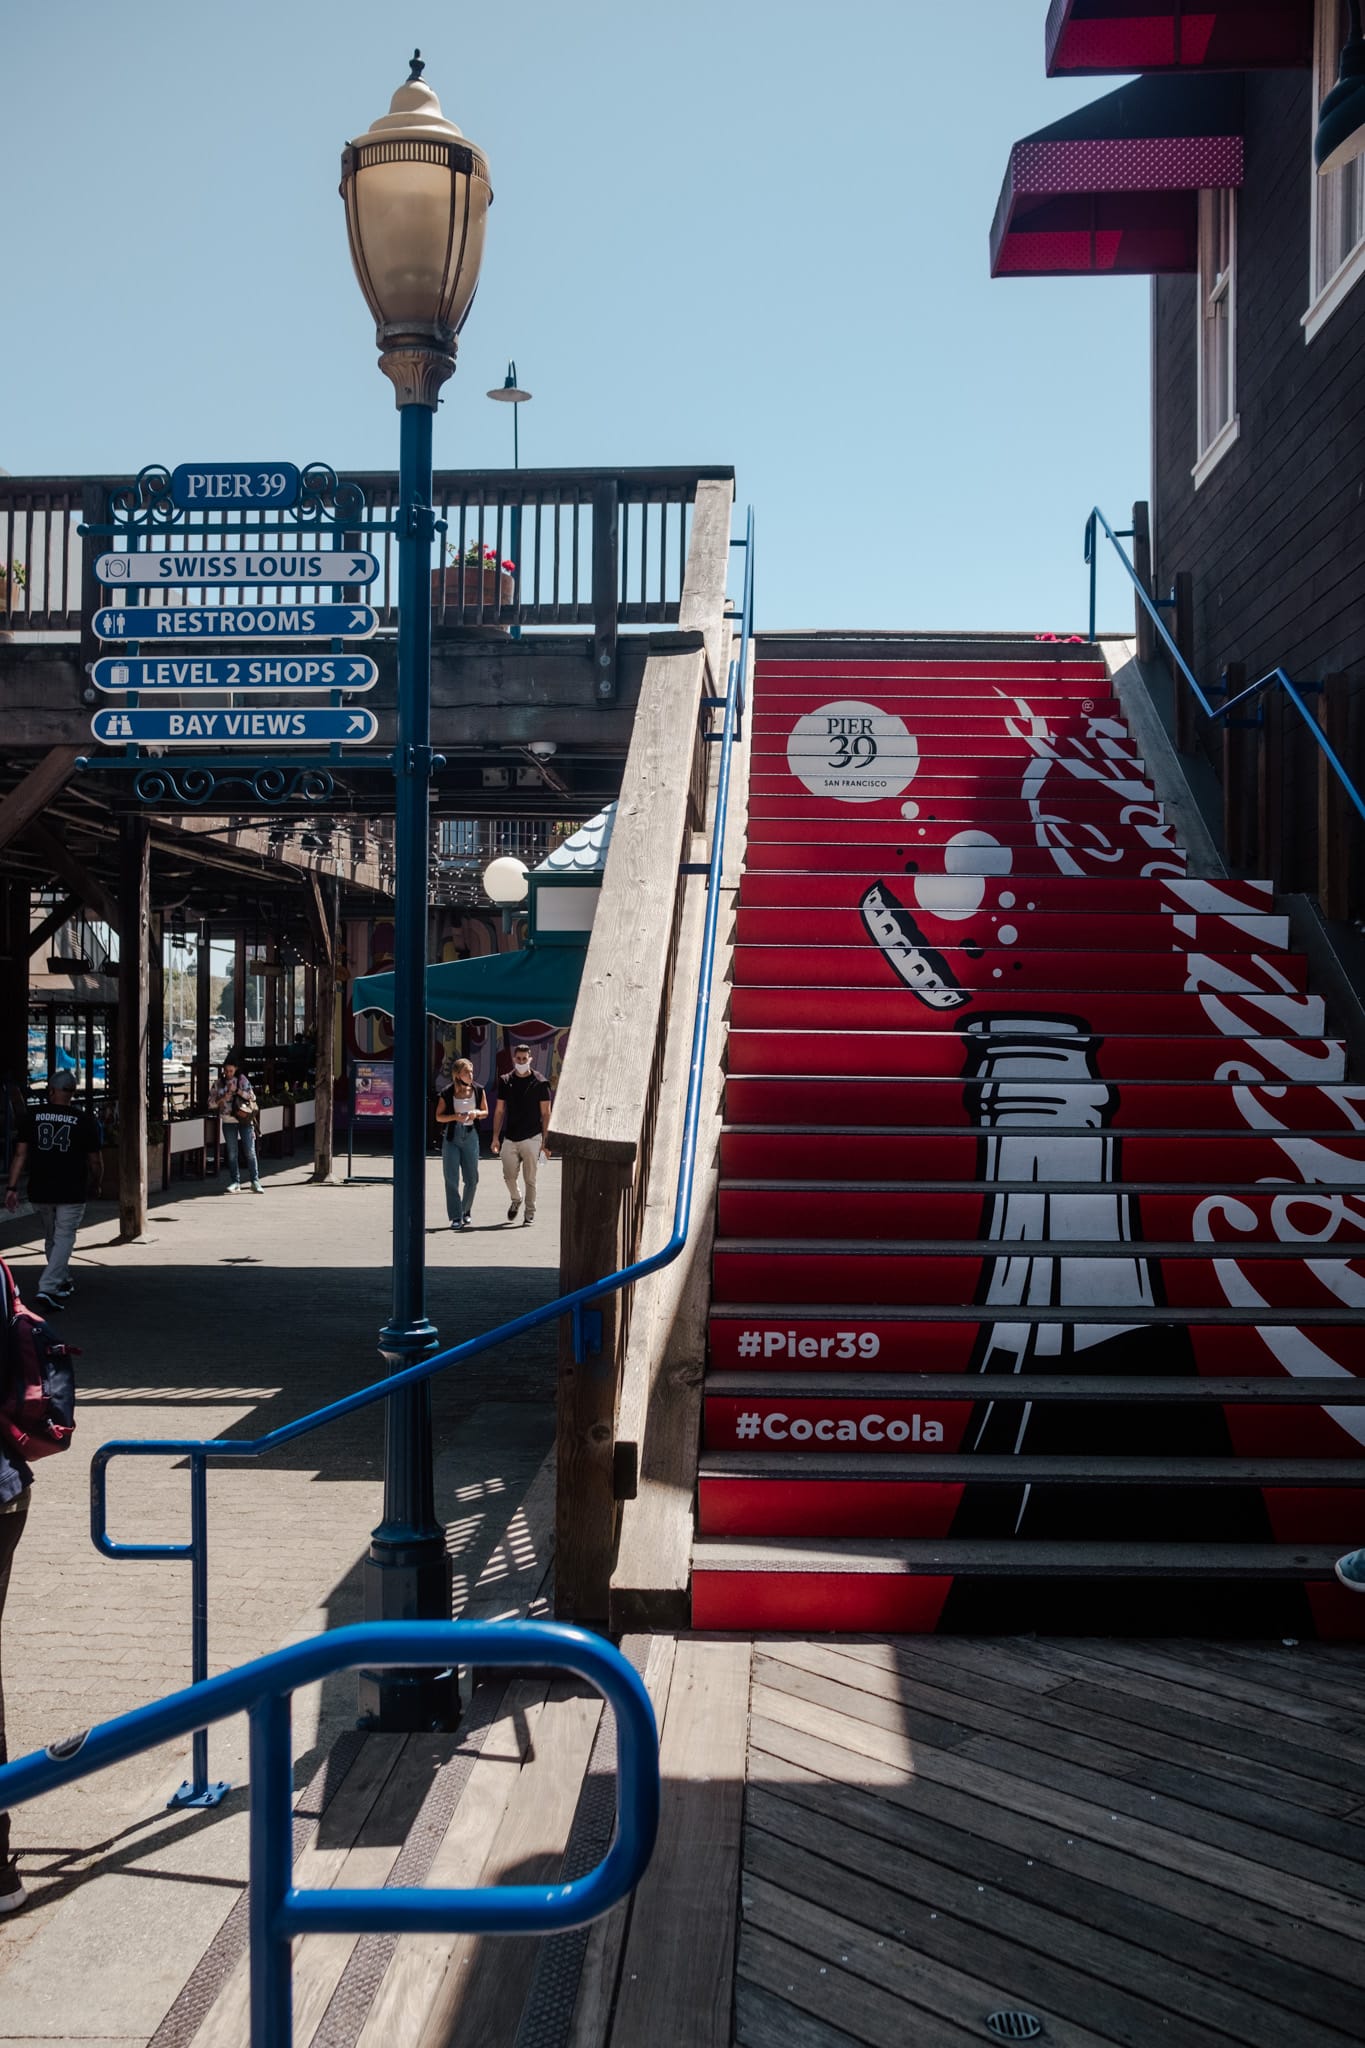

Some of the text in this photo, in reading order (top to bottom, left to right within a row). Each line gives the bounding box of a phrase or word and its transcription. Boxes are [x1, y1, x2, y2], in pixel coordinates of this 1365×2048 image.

[187, 473, 287, 498] PIER 39
[159, 556, 322, 578] SWISS LOUIS
[156, 610, 316, 634] RESTROOMS
[142, 662, 336, 684] LEVEL 2 SHOPS
[168, 714, 306, 735] BAY VIEWS
[827, 718, 875, 735] PIER
[828, 735, 877, 769] 39
[842, 780, 887, 788] FRANCISCO
[35, 1113, 78, 1125] RODRIGUEZ
[38, 1122, 71, 1152] 84
[738, 1331, 880, 1358] #Pier39
[736, 1412, 944, 1442] #CocaCola
